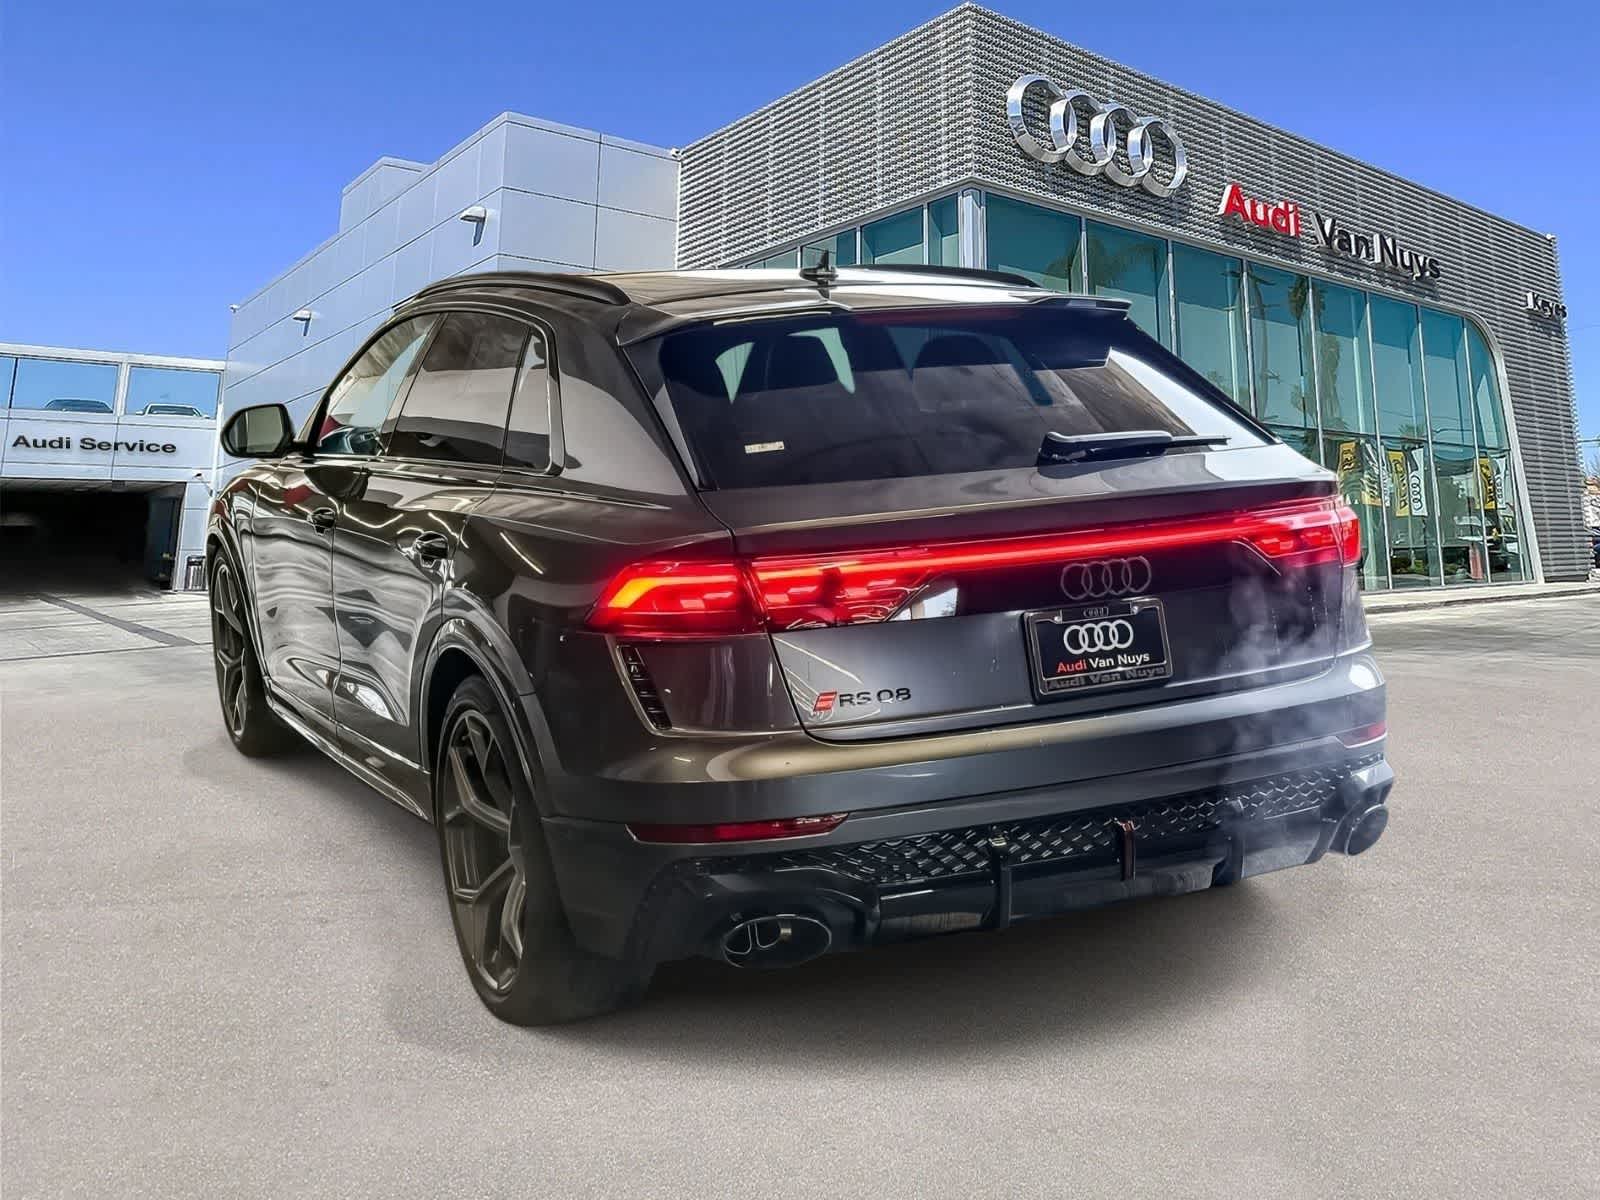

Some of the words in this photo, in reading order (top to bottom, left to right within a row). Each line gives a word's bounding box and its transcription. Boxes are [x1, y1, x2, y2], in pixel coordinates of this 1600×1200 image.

[1218, 182, 1302, 237] Audi
[1310, 211, 1371, 259] Van
[1371, 232, 1442, 281] Nuys
[12, 435, 71, 450] Audi
[79, 437, 178, 454] Service
[1056, 659, 1088, 673] Audi
[1089, 656, 1115, 669] Van
[1117, 652, 1151, 666] Nuys
[1048, 676, 1086, 690] Audi
[1088, 671, 1121, 683] Van
[1124, 666, 1166, 680] Nuys
[838, 691, 872, 707] RS
[876, 687, 912, 704] Q8
